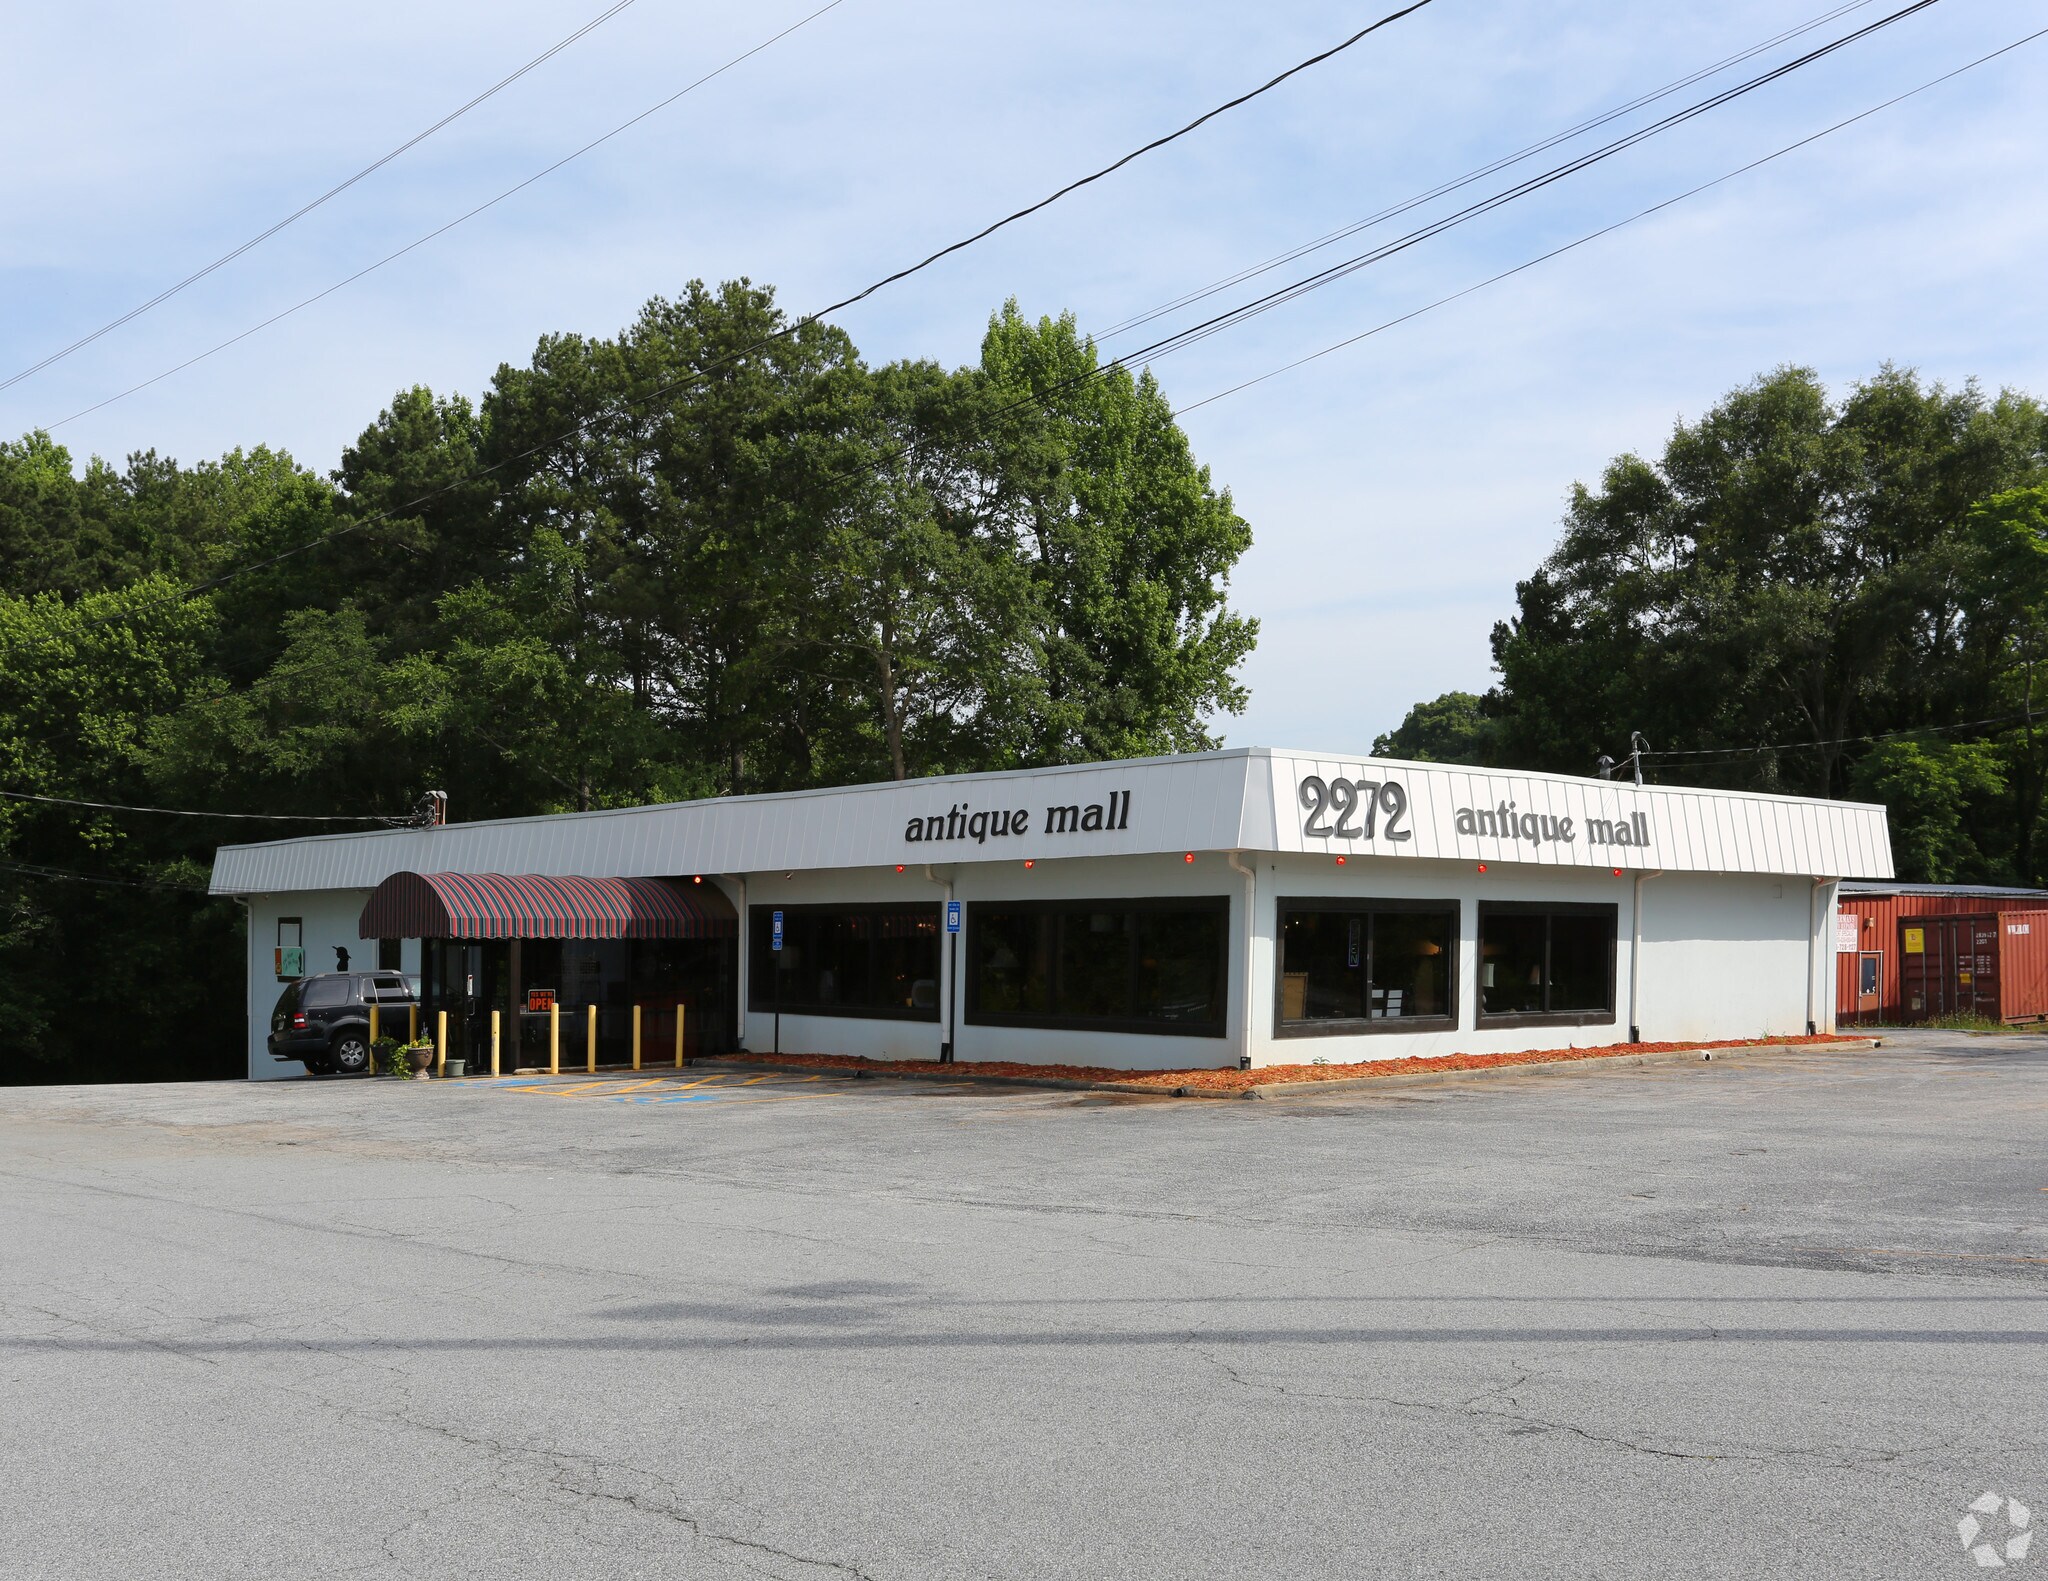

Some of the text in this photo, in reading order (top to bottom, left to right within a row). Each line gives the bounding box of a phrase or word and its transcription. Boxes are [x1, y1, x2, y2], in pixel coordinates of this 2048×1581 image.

[904, 789, 1131, 845] antique mall
[1299, 775, 1412, 842] 2272
[1456, 800, 1652, 847] antique mall
[530, 998, 554, 1010] OPEN
